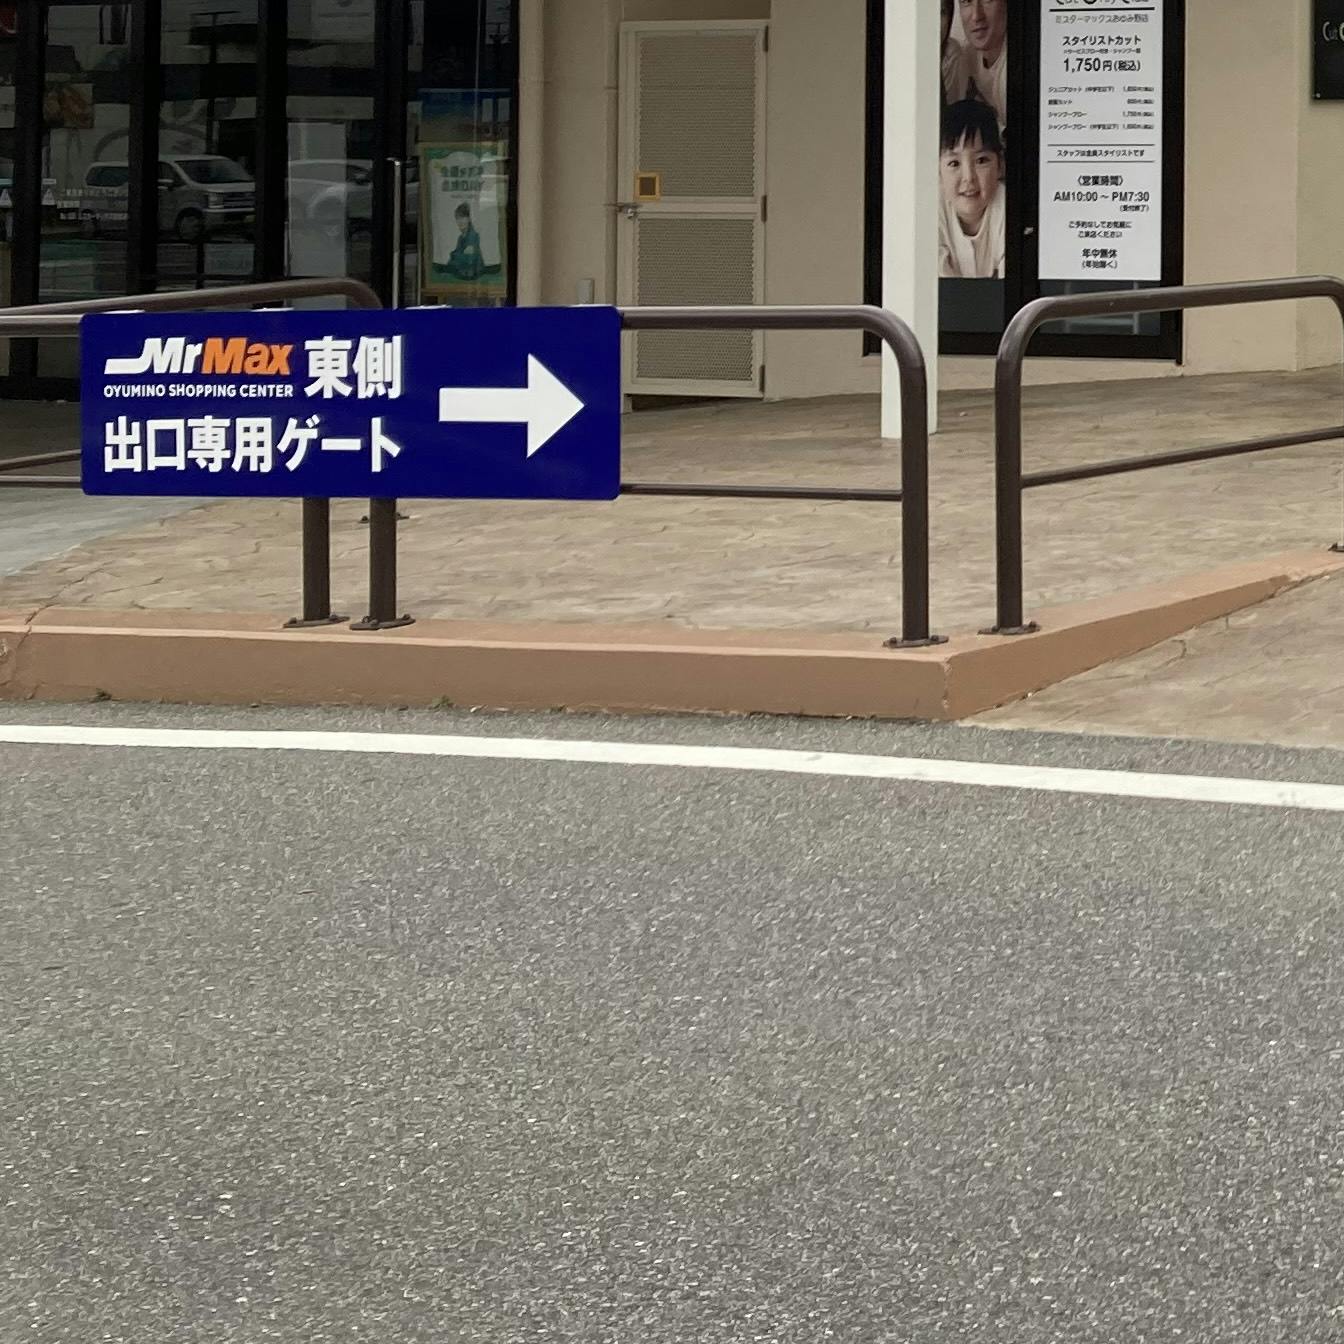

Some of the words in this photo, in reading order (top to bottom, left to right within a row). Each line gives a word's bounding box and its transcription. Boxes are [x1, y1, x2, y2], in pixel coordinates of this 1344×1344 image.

[1062, 35, 1142, 46] スタイリストカット
[104, 337, 293, 375] MrMax
[304, 335, 401, 399] 東側
[103, 384, 166, 398] OYUMINO
[168, 384, 236, 398] SHOPPING
[239, 384, 294, 398] CENTER
[103, 415, 401, 473] 出口専用ゲート
